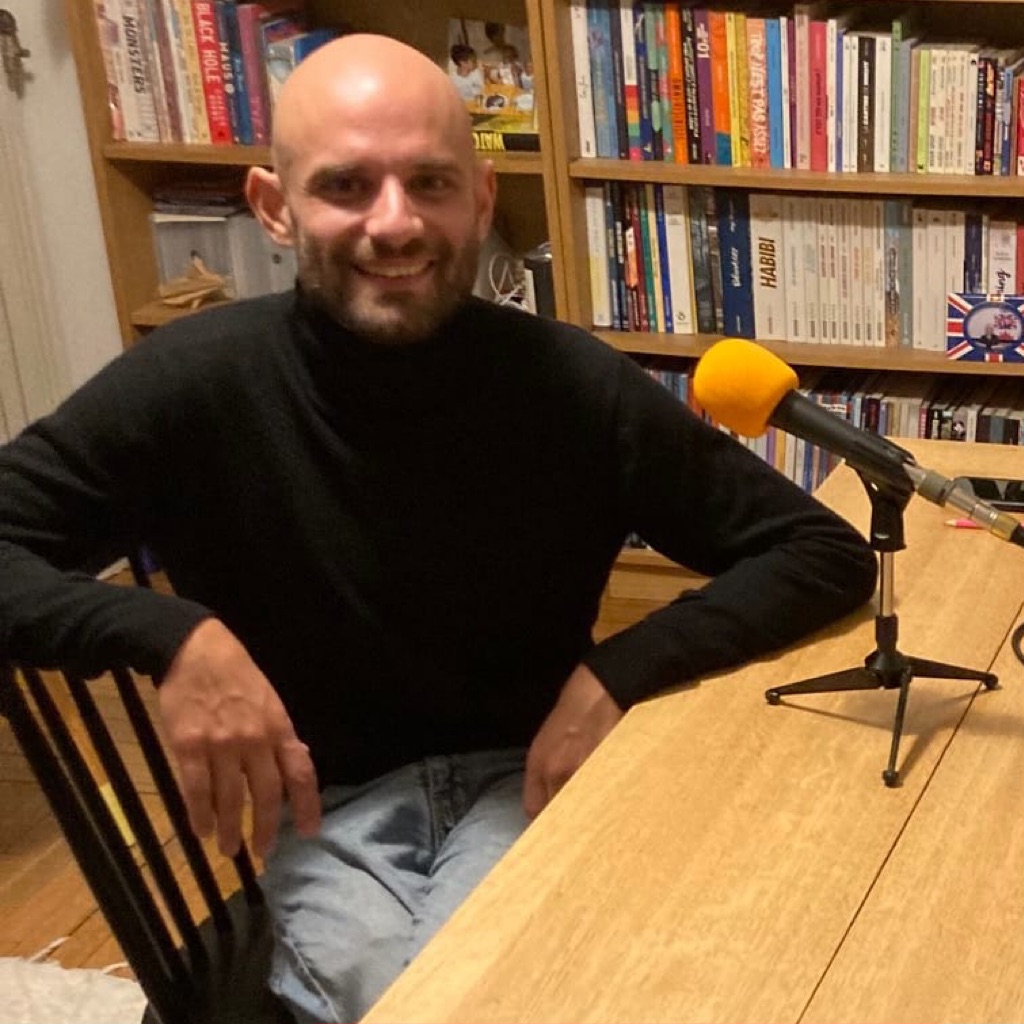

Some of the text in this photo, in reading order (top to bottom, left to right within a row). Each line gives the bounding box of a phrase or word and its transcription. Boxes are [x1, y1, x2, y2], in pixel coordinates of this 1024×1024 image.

[122, 15, 146, 94] MONSTERS
[195, 2, 221, 84] BLACK HOLE
[219, 41, 233, 81] MAUS
[752, 98, 766, 122] PAS
[471, 132, 506, 151] WATC
[758, 236, 778, 289] HABIBI
